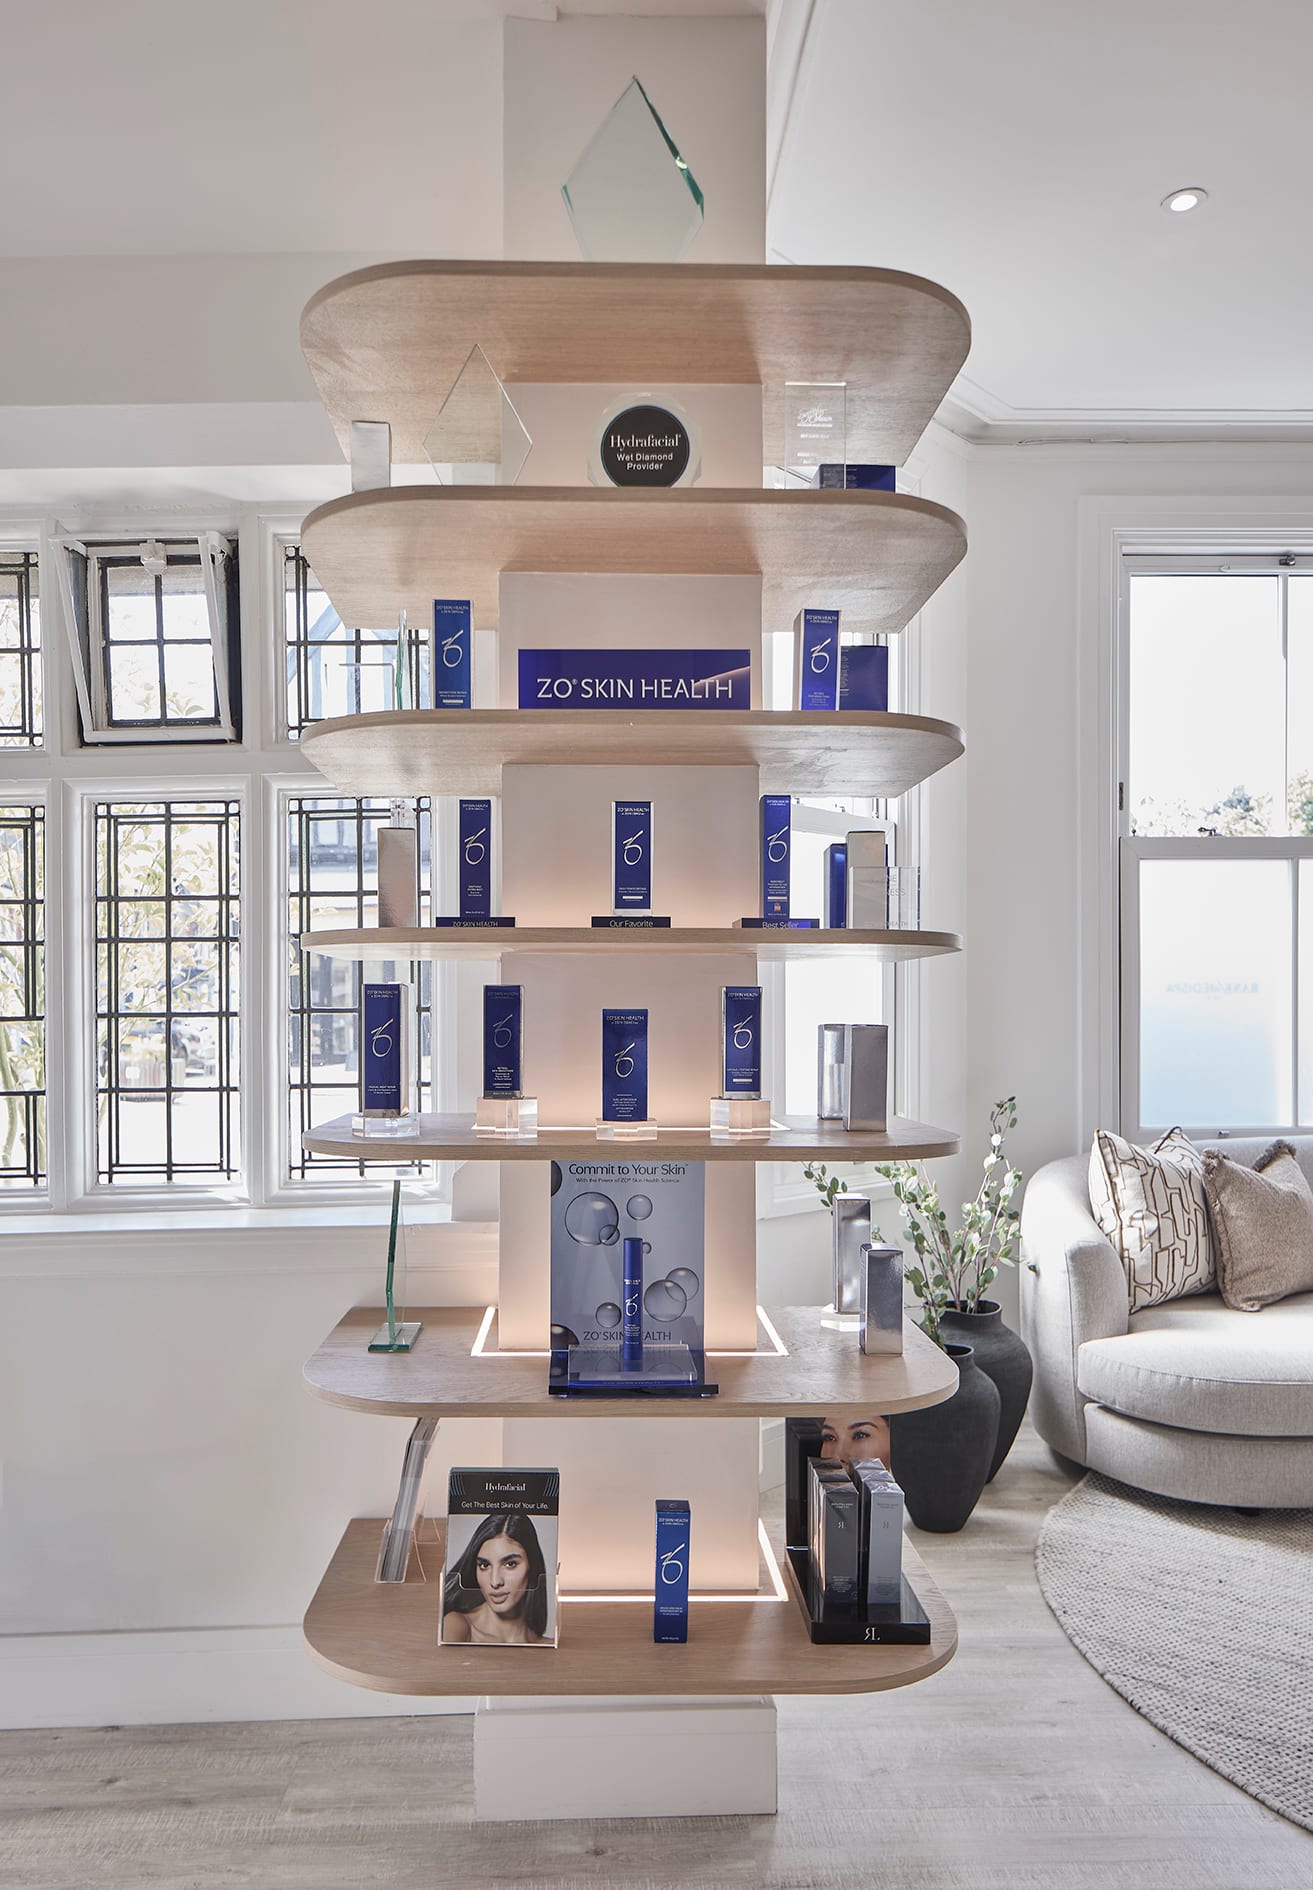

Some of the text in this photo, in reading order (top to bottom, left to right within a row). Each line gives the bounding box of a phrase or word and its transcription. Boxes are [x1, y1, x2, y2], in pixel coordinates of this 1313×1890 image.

[617, 453, 674, 461] Wet Diamond
[627, 462, 664, 471] Provider
[580, 678, 634, 699] SKIN
[641, 678, 733, 699] HEALTH
[609, 920, 654, 928] Our Favorite
[568, 1163, 615, 1175] Commit
[617, 1163, 630, 1175] to
[632, 1164, 659, 1175] Your
[485, 1482, 526, 1494] Hydrafacial
[461, 1501, 473, 1509] Get
[474, 1501, 485, 1509] The
[486, 1501, 500, 1509] Best
[501, 1501, 514, 1509] Skin
[514, 1501, 521, 1509] of
[522, 1501, 536, 1509] Your
